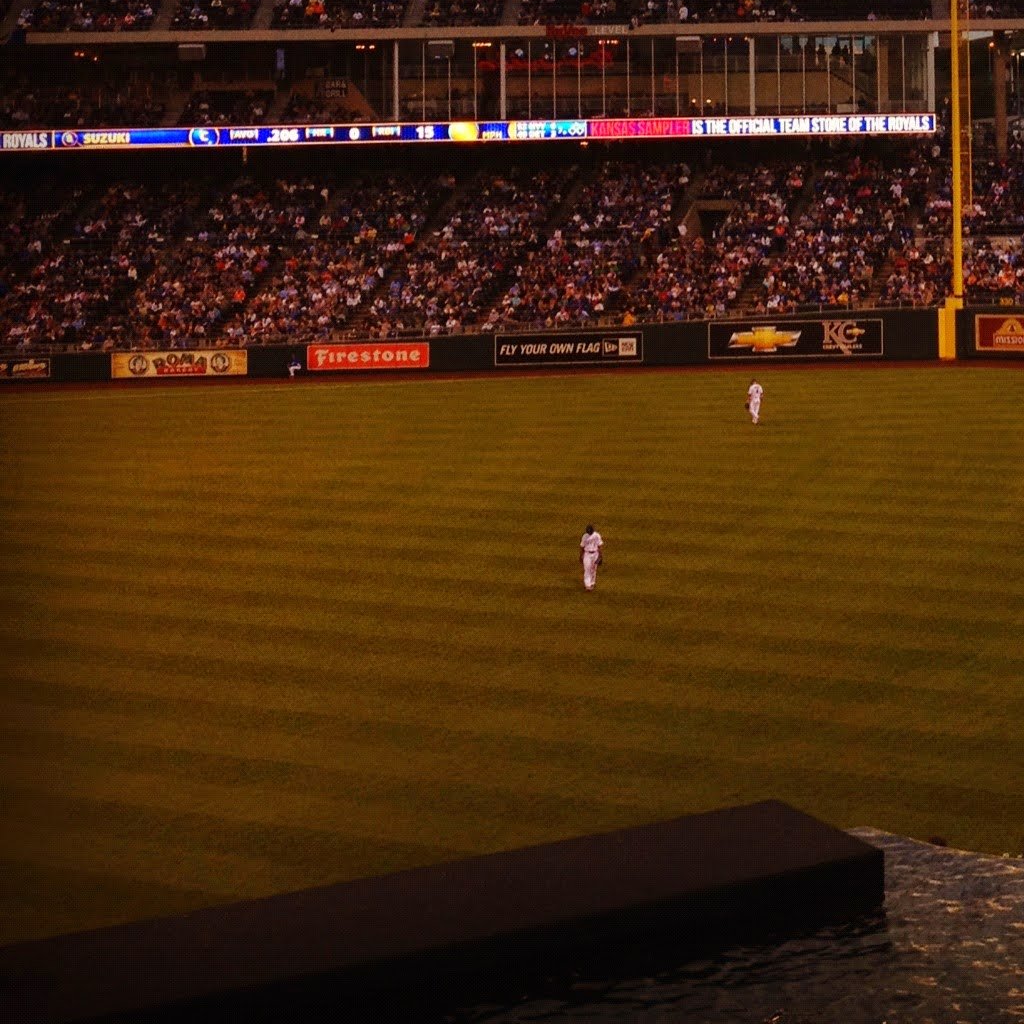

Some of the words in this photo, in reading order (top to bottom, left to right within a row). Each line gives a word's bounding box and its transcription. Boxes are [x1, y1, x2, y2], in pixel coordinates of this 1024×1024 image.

[595, 25, 628, 35] LEVEL
[591, 121, 635, 137] KANSAS
[637, 120, 690, 135] SAMPLER
[692, 120, 704, 134] IS
[705, 120, 727, 134] THE
[728, 119, 774, 133] OFFICIAL
[779, 118, 810, 132] TEAM
[812, 118, 847, 132] STORE
[848, 117, 864, 131] OF
[865, 117, 887, 131] THE
[888, 116, 930, 131] ROYALS
[83, 132, 131, 144] SUZUKI
[267, 129, 299, 142] .206
[349, 127, 360, 140] 0
[416, 126, 434, 139] 15
[2, 132, 48, 149] ROYALS
[822, 319, 858, 351] KC
[499, 344, 518, 356] FLY
[520, 343, 547, 355] YOUR
[549, 342, 574, 354] OWN
[576, 342, 601, 354] FLAG
[314, 347, 421, 367] Firestone
